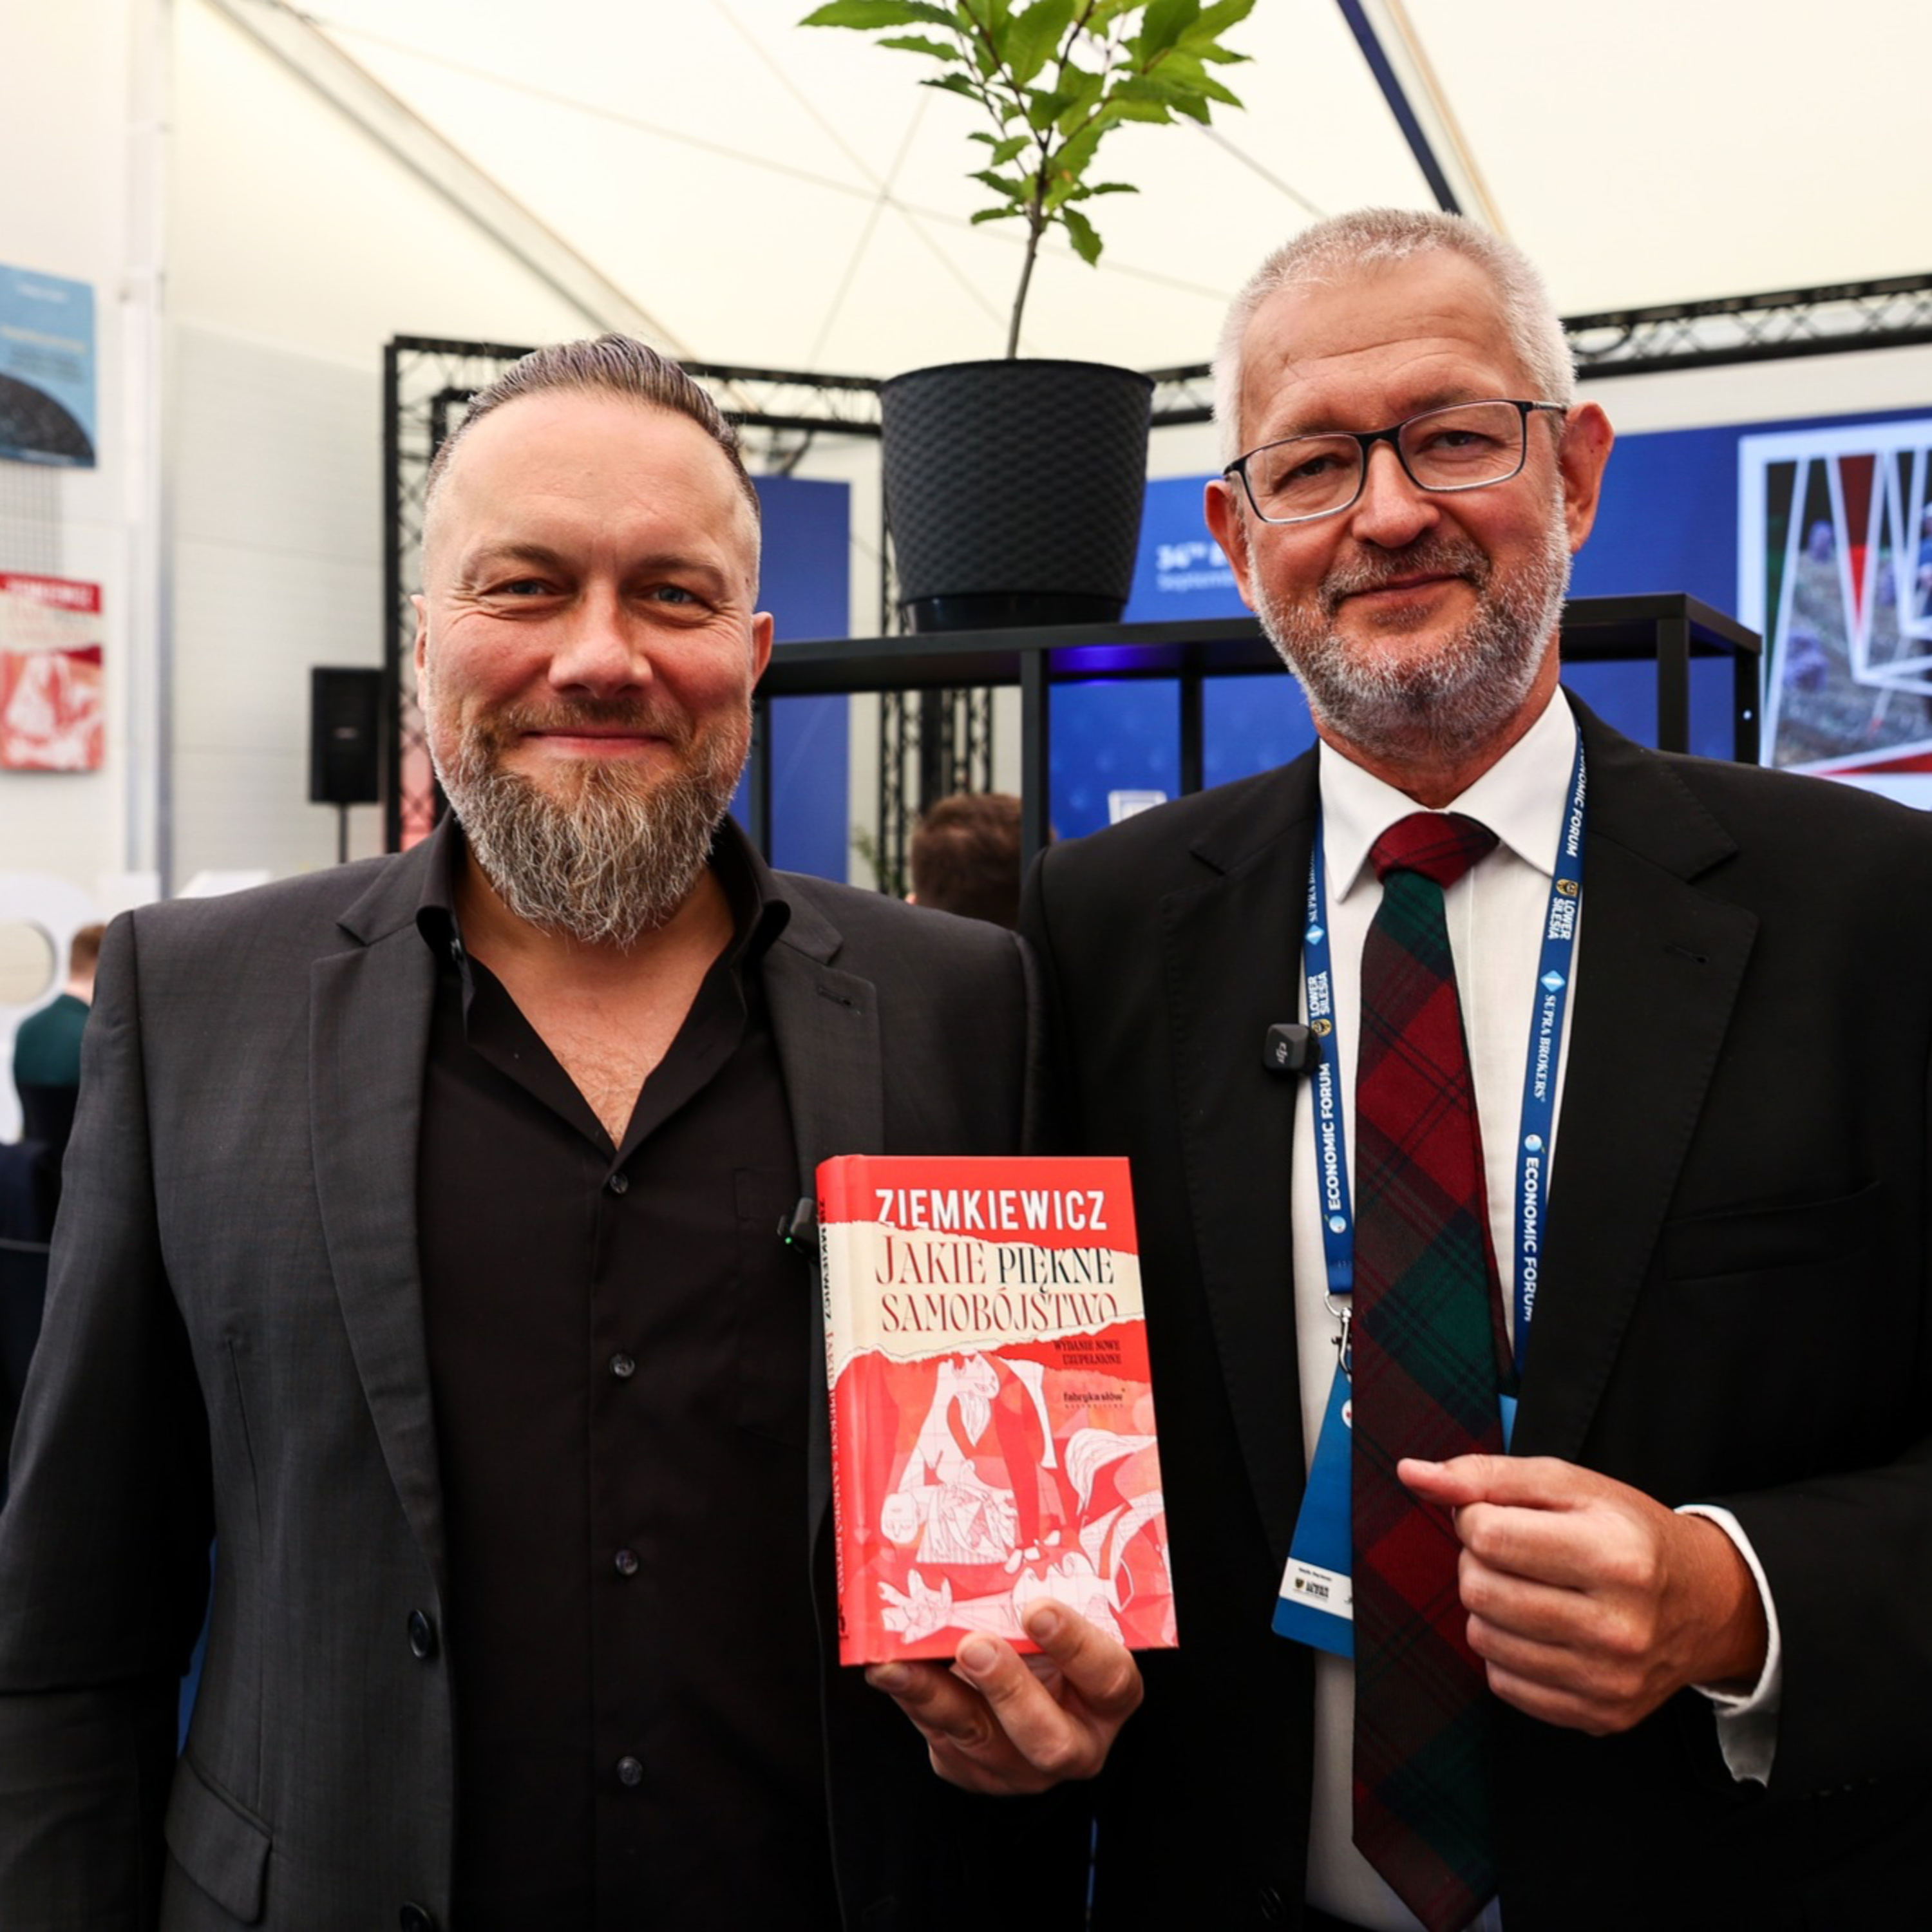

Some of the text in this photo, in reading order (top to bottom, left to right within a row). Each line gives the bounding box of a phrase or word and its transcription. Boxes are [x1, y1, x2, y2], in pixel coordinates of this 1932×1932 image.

[1566, 808, 1583, 857] FORUM
[1308, 886, 1318, 923] SUPRA
[1548, 897, 1561, 940] SILESIA
[1560, 900, 1575, 940] LOWER
[1307, 974, 1320, 1018] LOWER
[1317, 971, 1331, 1016] SILESIA
[1541, 994, 1557, 1035] SUPRA
[1319, 1063, 1341, 1211] ECONOMIC FORUM
[875, 1188, 1108, 1231] ZIEMKIEWICZ
[1524, 1157, 1539, 1322] ECONOMIC FORUM
[875, 1235, 1115, 1294] JAKIE PIĘKNE
[881, 1287, 1118, 1333] SAMOBÓJSTWO
